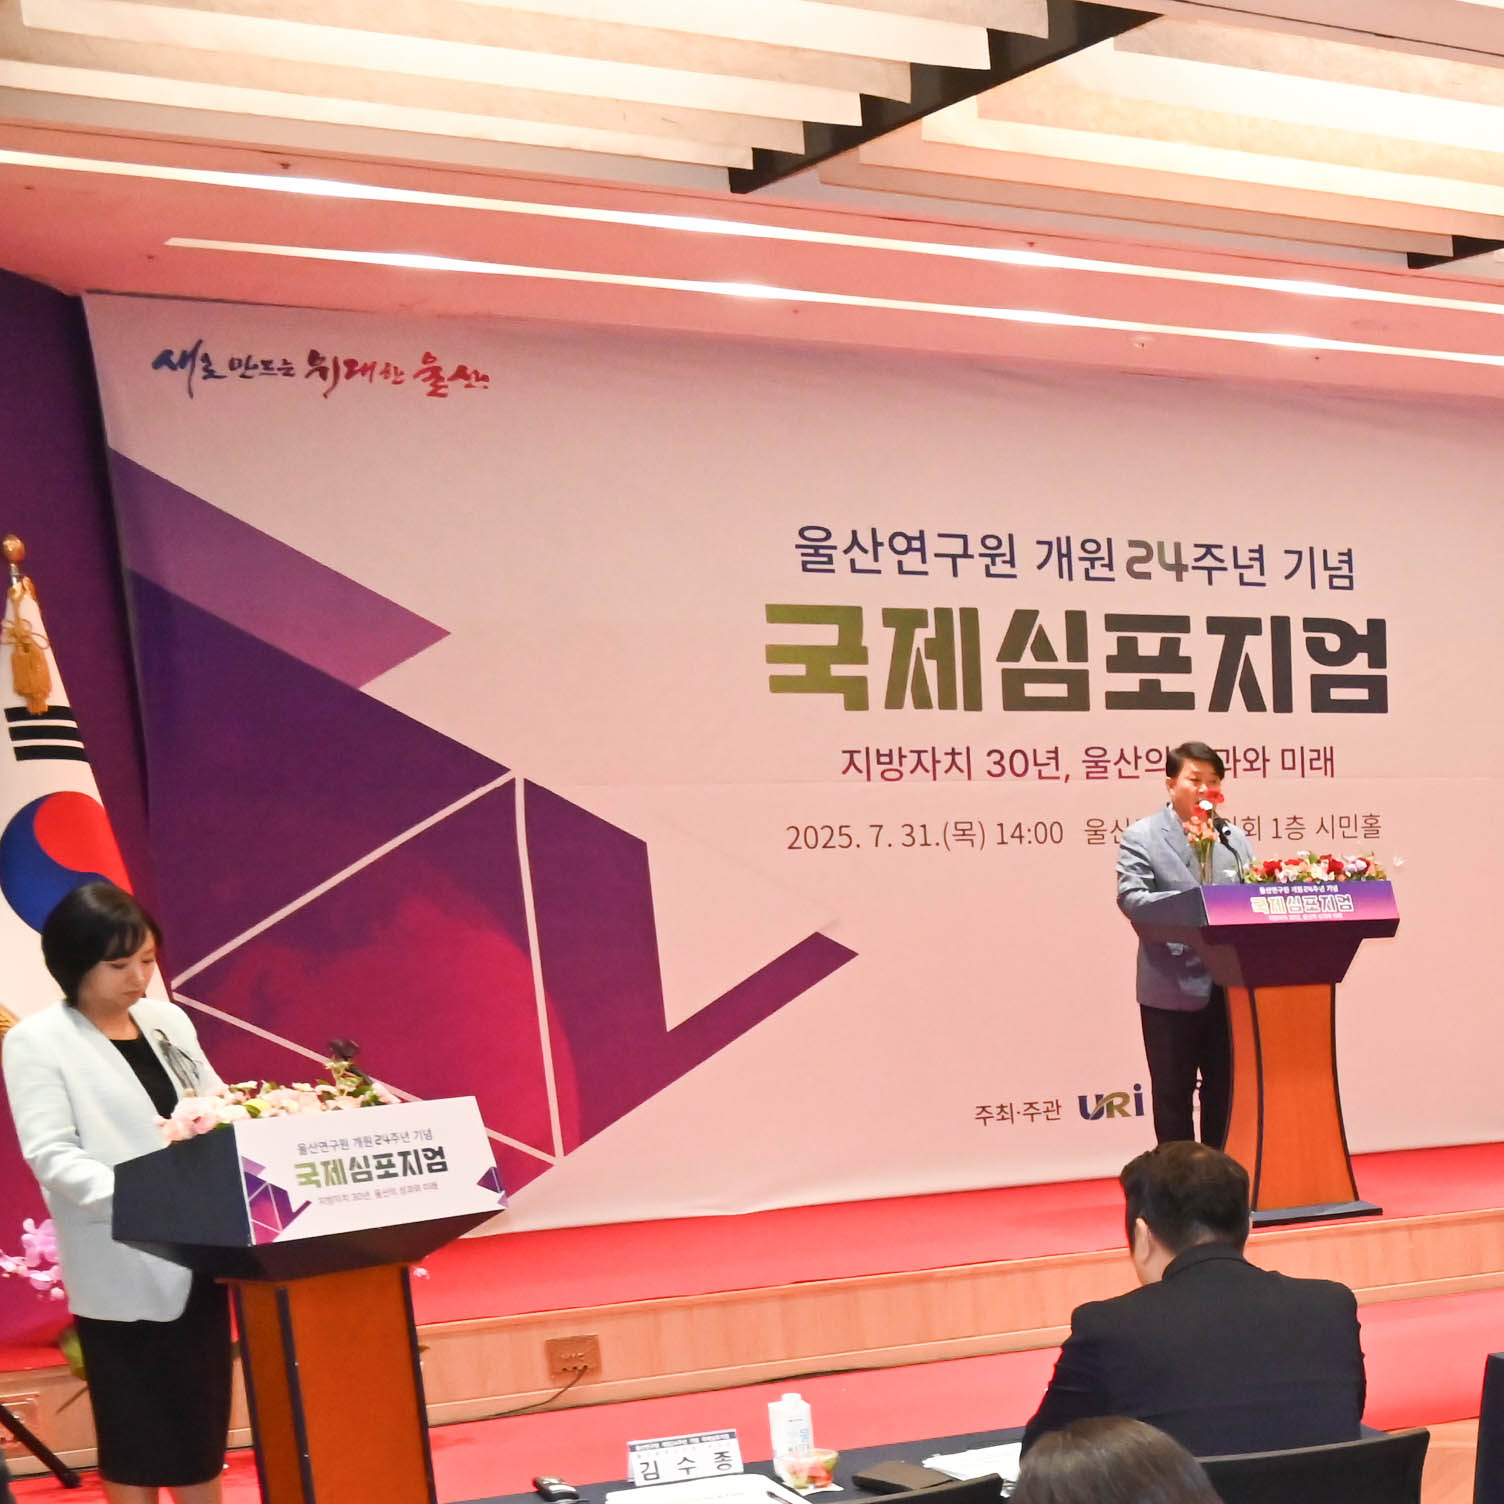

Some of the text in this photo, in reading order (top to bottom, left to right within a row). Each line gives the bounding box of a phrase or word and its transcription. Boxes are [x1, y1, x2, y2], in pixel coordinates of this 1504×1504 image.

[413, 351, 490, 398] 울산
[795, 525, 1017, 579] 울산연구원
[1284, 547, 1355, 590] 기념
[766, 604, 1389, 714] 국제심포지엄
[841, 745, 973, 782] 지방자치
[985, 745, 1072, 784] 30년,
[1082, 745, 1169, 780] 울산의
[1281, 745, 1336, 778] 미래
[786, 825, 860, 850] 2025.
[869, 824, 892, 848] 7.
[996, 820, 1064, 846] 14:00
[1272, 815, 1306, 841] 1층
[1315, 813, 1382, 841] 시민홀
[1250, 894, 1355, 914] 국제심포지엄
[974, 1099, 1062, 1127] 주최·주관
[297, 1138, 350, 1155] 울산연구원
[414, 1128, 433, 1141] 기념
[294, 1146, 449, 1188] 국제심포지엄
[639, 1450, 733, 1481] 김수종
